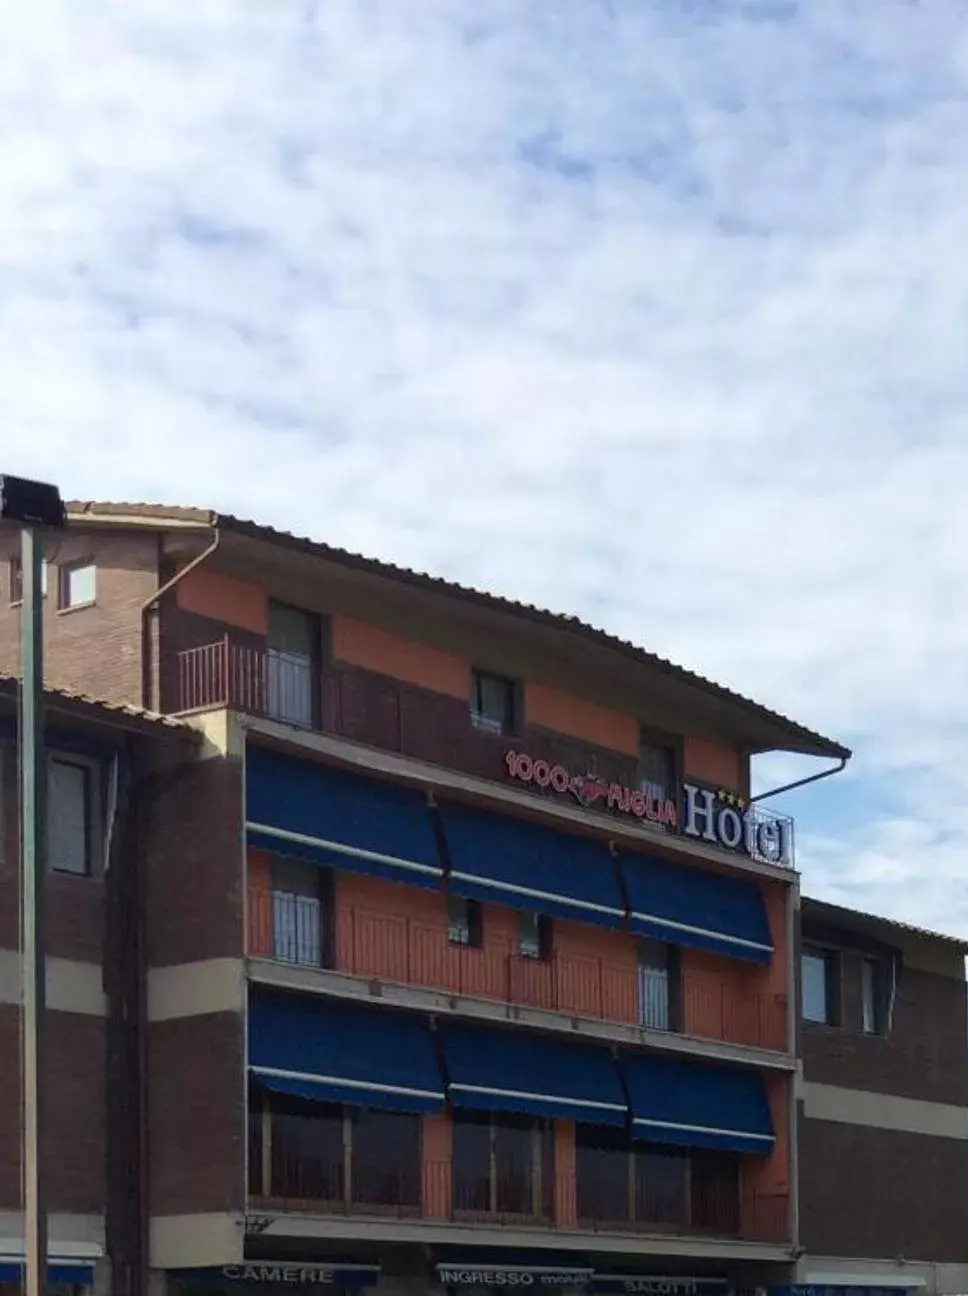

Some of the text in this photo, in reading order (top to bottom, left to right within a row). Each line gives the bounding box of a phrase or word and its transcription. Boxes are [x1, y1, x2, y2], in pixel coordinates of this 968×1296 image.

[505, 749, 570, 793] 1000
[683, 783, 792, 863] Hotel
[222, 1264, 334, 1284] CAMERE
[439, 1270, 534, 1285] INGRESSO
